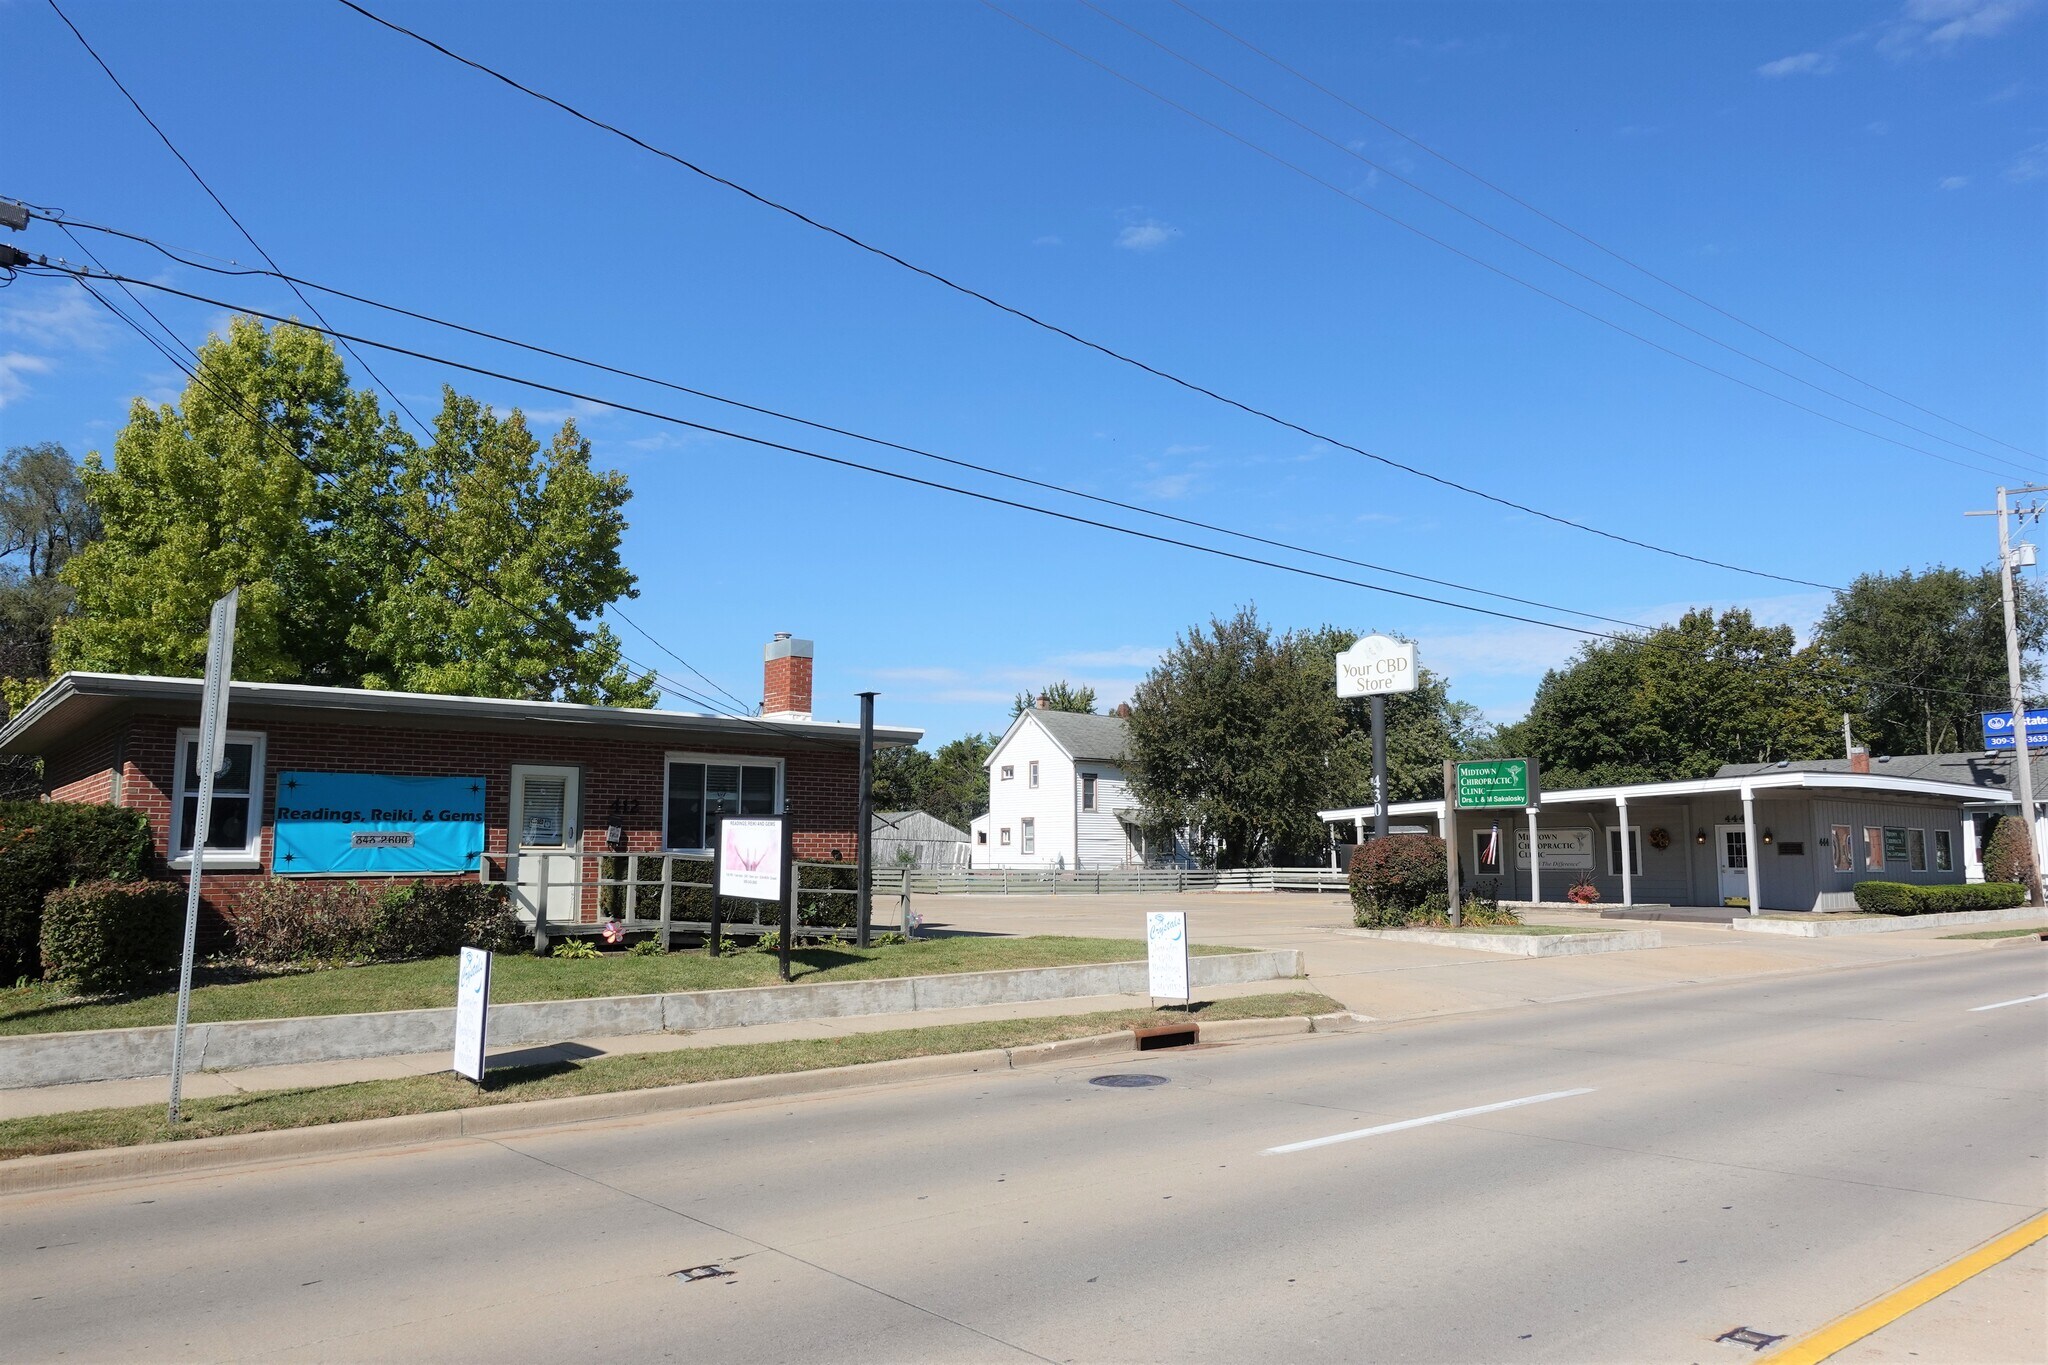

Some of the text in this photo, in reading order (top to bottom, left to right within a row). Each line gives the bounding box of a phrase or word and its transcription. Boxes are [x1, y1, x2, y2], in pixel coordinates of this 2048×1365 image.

[1343, 657, 1408, 678] Your CBD
[1991, 735, 2048, 745] 309-3-3633
[1460, 768, 1497, 776] MIDTOWN
[1461, 777, 1512, 786] CHIROPRACTIC
[1373, 774, 1382, 816] 430
[1461, 786, 1485, 795] CLINIC
[1493, 795, 1525, 805] Sakalosky
[277, 807, 483, 824] Readings, Reiki, & Gems
[1518, 833, 1557, 841] MIOWN
